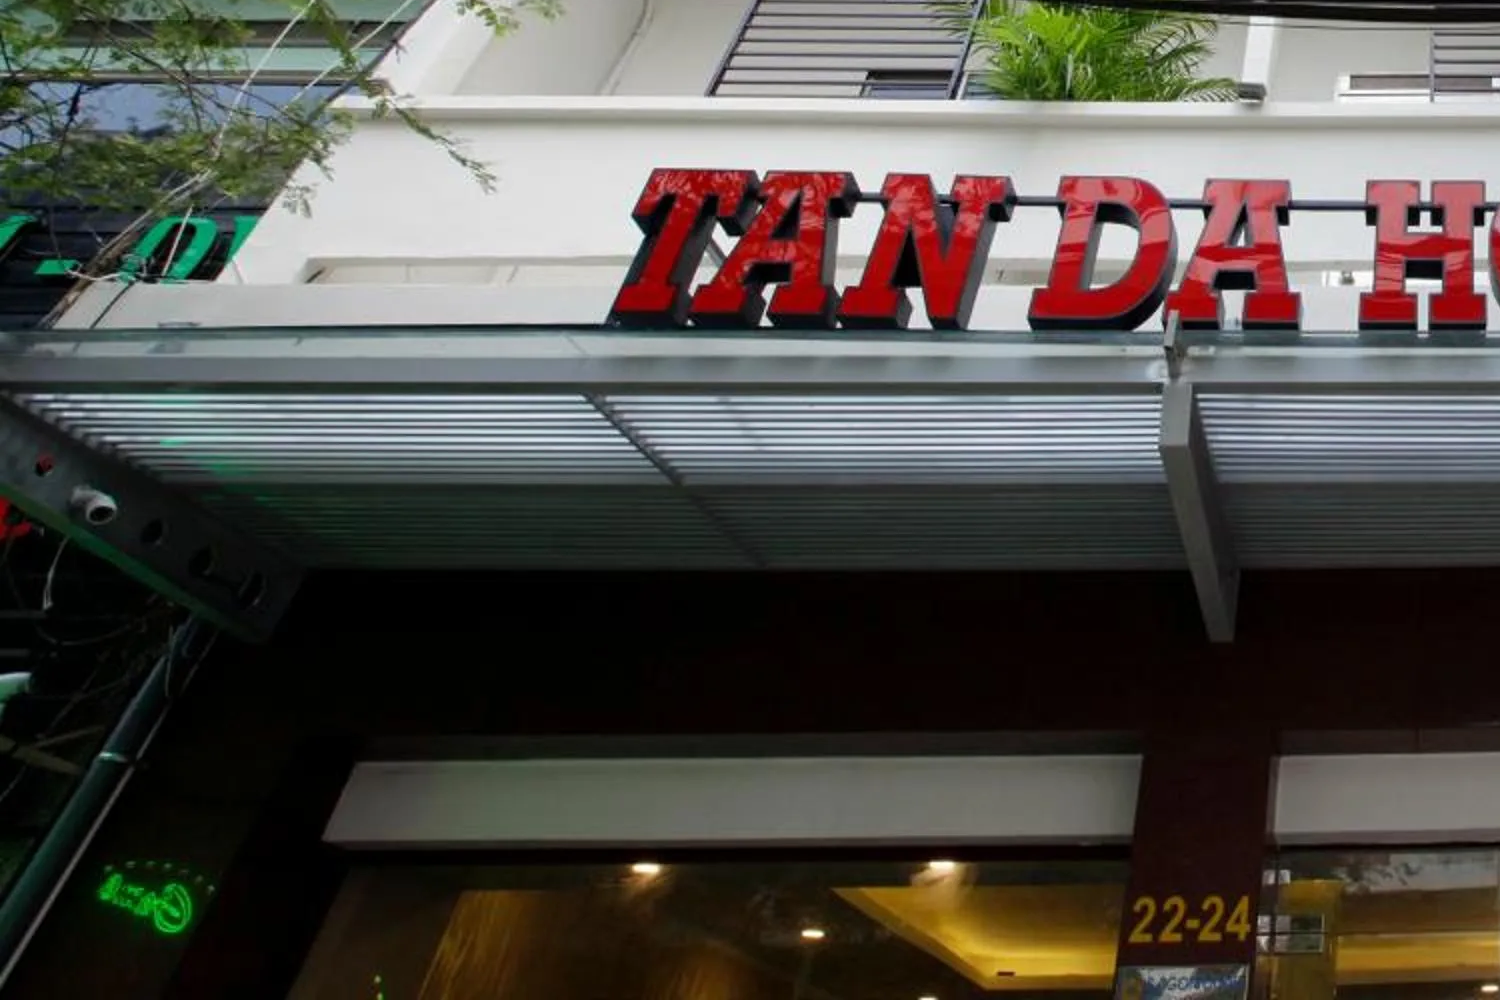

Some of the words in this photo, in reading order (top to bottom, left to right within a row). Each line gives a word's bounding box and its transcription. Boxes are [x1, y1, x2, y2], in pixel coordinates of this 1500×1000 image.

[606, 167, 1019, 331] TAN
[1028, 175, 1303, 331] DA
[1128, 895, 1251, 943] 22-24
